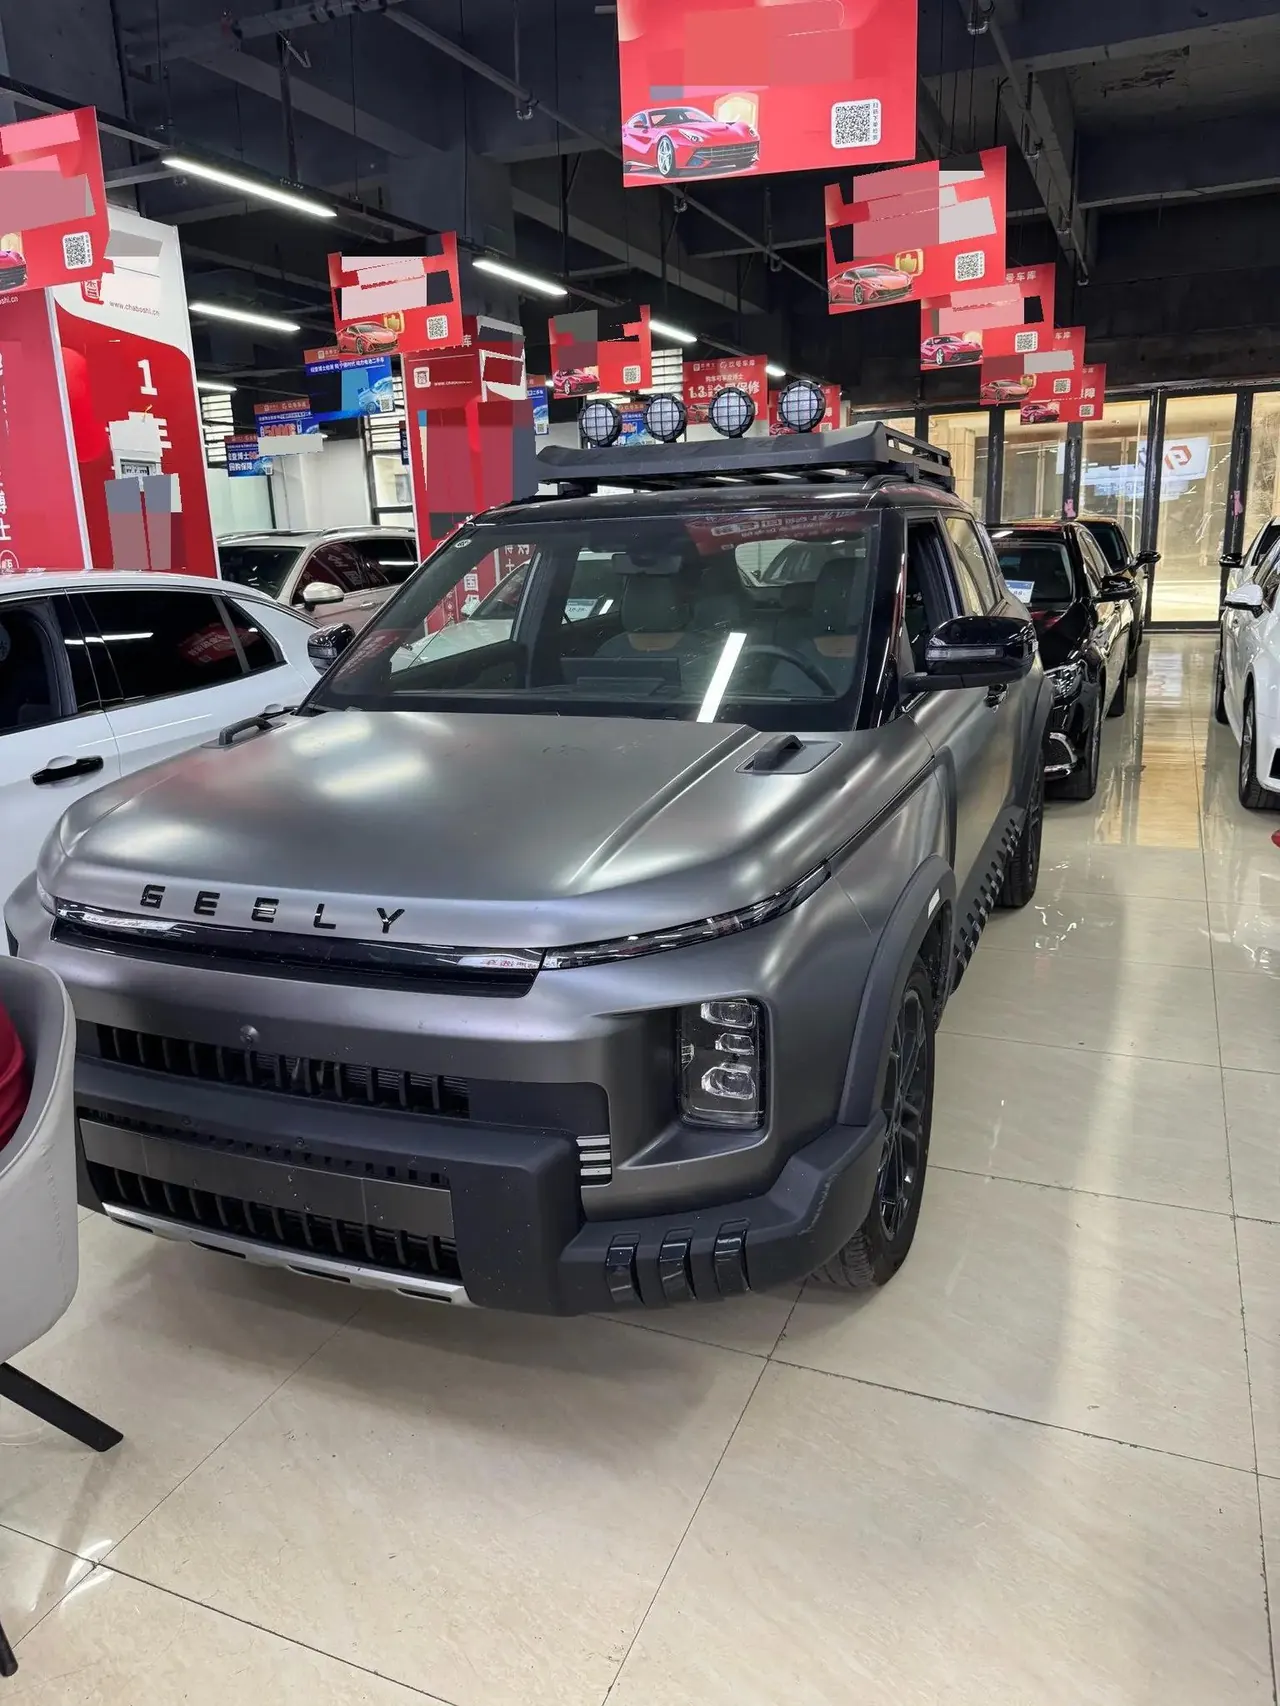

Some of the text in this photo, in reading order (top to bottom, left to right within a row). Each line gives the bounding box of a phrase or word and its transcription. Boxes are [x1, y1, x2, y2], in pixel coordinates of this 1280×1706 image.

[109, 301, 160, 316] www.chaboshi.cn
[138, 359, 158, 396] 1
[140, 884, 405, 933] GEELY
